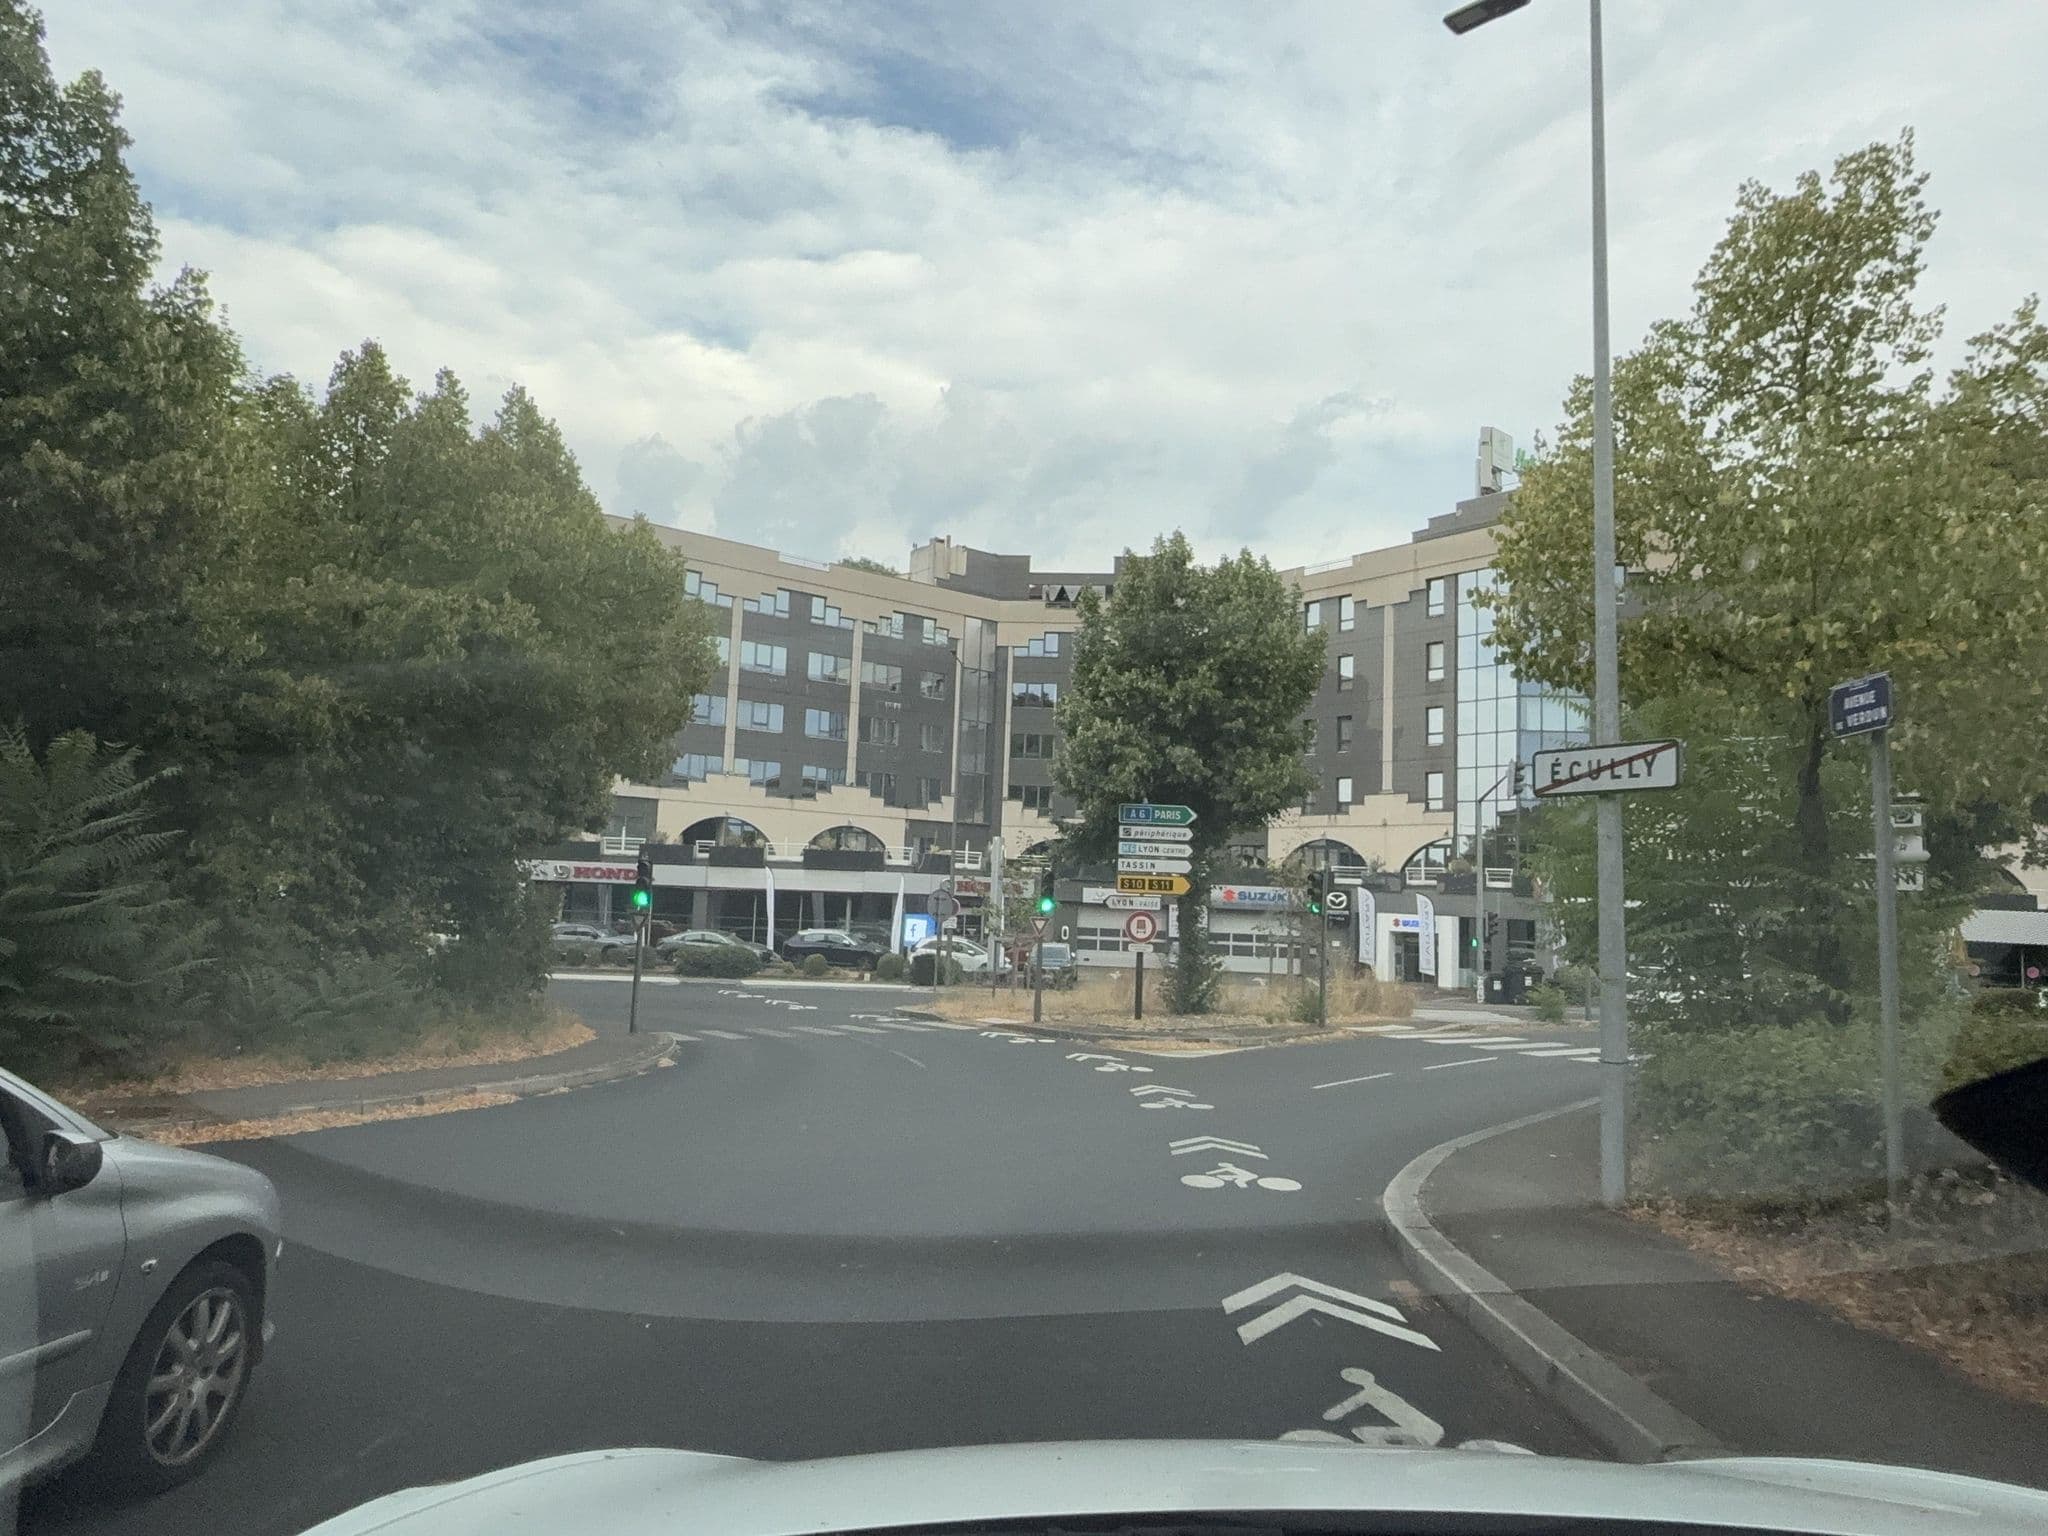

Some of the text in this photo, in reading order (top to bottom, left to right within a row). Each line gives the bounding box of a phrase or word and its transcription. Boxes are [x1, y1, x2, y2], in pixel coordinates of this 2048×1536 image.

[1844, 690, 1875, 709] AVENUE
[1847, 706, 1887, 727] VERDUN
[1551, 754, 1657, 784] ÉCULLY
[1154, 810, 1181, 820] PARIS
[1134, 828, 1187, 838] périphérique
[1138, 844, 1159, 853] LYON
[1121, 861, 1156, 869] TASSIN
[574, 866, 640, 880] HOND
[1237, 890, 1289, 901] SUZUK
[1112, 899, 1134, 907] LYON
